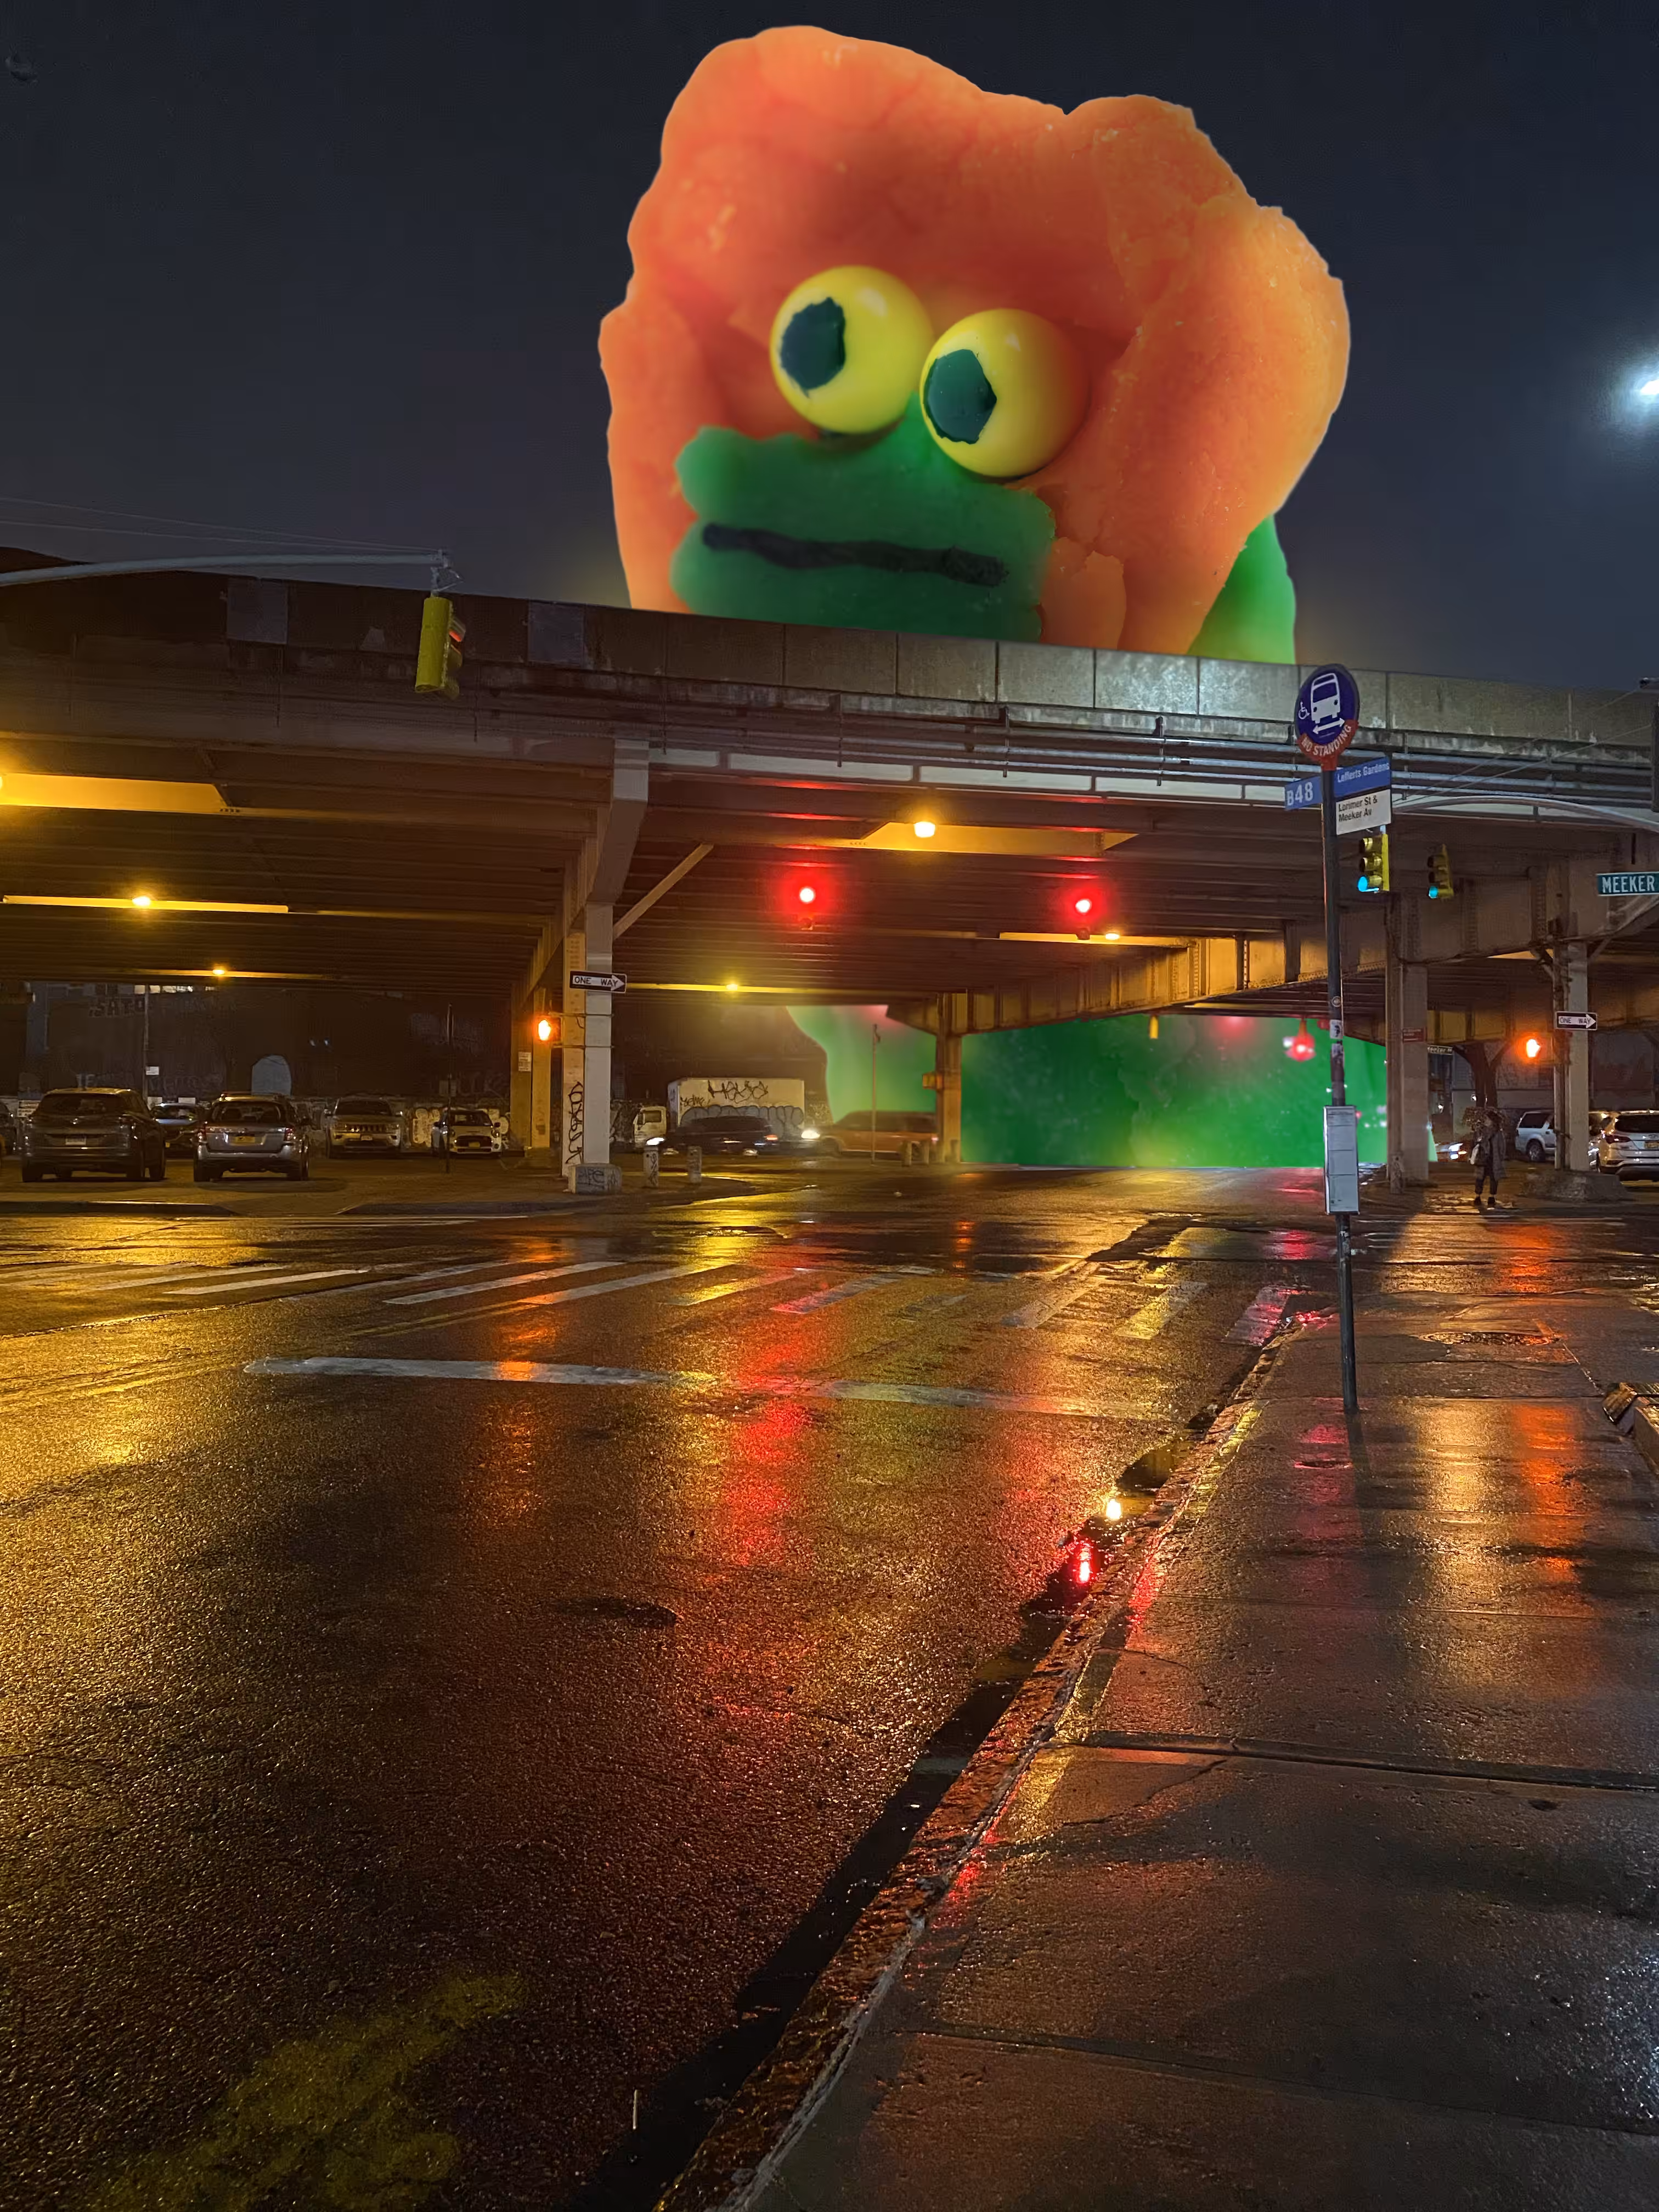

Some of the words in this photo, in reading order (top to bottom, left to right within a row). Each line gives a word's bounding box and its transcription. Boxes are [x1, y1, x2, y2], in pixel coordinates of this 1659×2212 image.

[1301, 737, 1313, 752] NO
[1313, 724, 1352, 757] STANDING
[1286, 782, 1313, 806] B48
[1339, 800, 1363, 811] Lorimer
[1364, 797, 1371, 805] St
[1373, 795, 1378, 804] &
[1339, 811, 1362, 822] Meeker
[1363, 808, 1372, 817] Av
[1602, 876, 1655, 893] MEEKER
[601, 978, 618, 987] WAY
